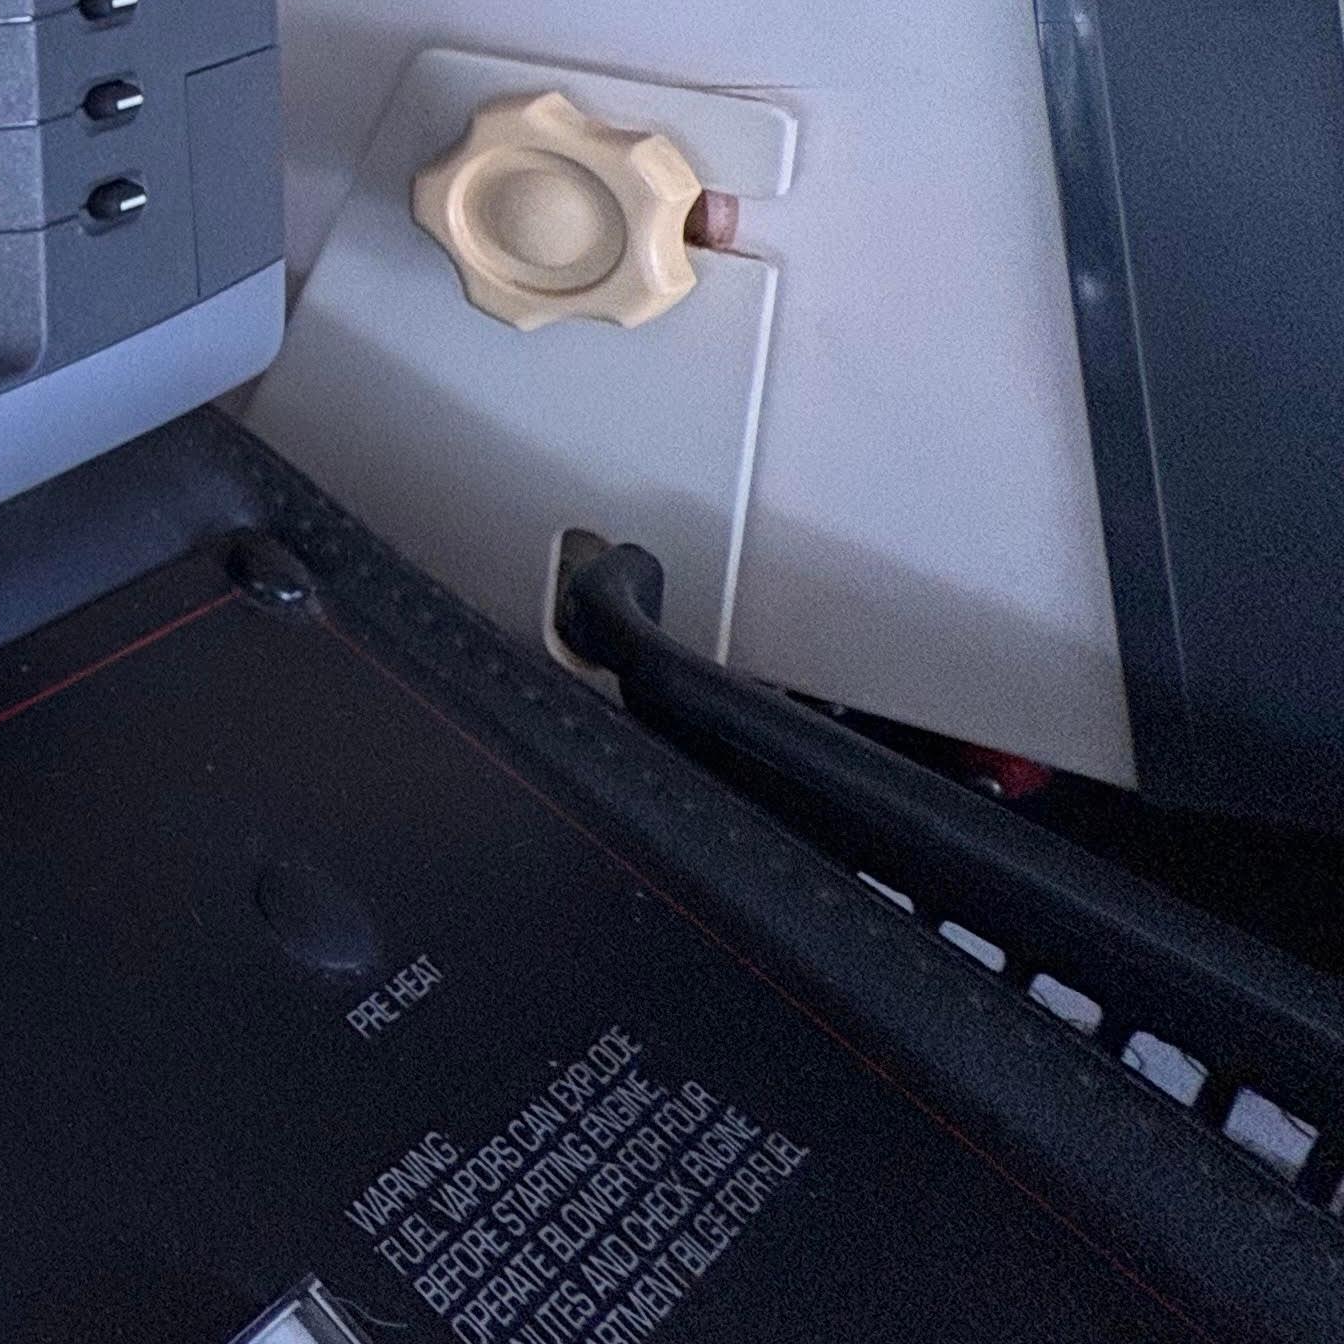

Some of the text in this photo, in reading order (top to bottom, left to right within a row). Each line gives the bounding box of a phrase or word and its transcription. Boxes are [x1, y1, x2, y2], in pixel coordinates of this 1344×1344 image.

[346, 954, 443, 1038] PRE HEAT
[378, 1024, 643, 1276] FUEL VAPORS CAN EXPLODE
[414, 1217, 511, 1316] BEFORE
[492, 1132, 597, 1237] STARTING
[451, 1080, 719, 1344] OPERATE BLOWER FOR FOUR
[580, 1233, 640, 1301] AND
[621, 1169, 702, 1252] CHECK
[680, 1105, 762, 1187] ENGINE
[668, 1204, 740, 1278] BILGE
[715, 1168, 773, 1224] FOR
[748, 1131, 811, 1188] FUEL
